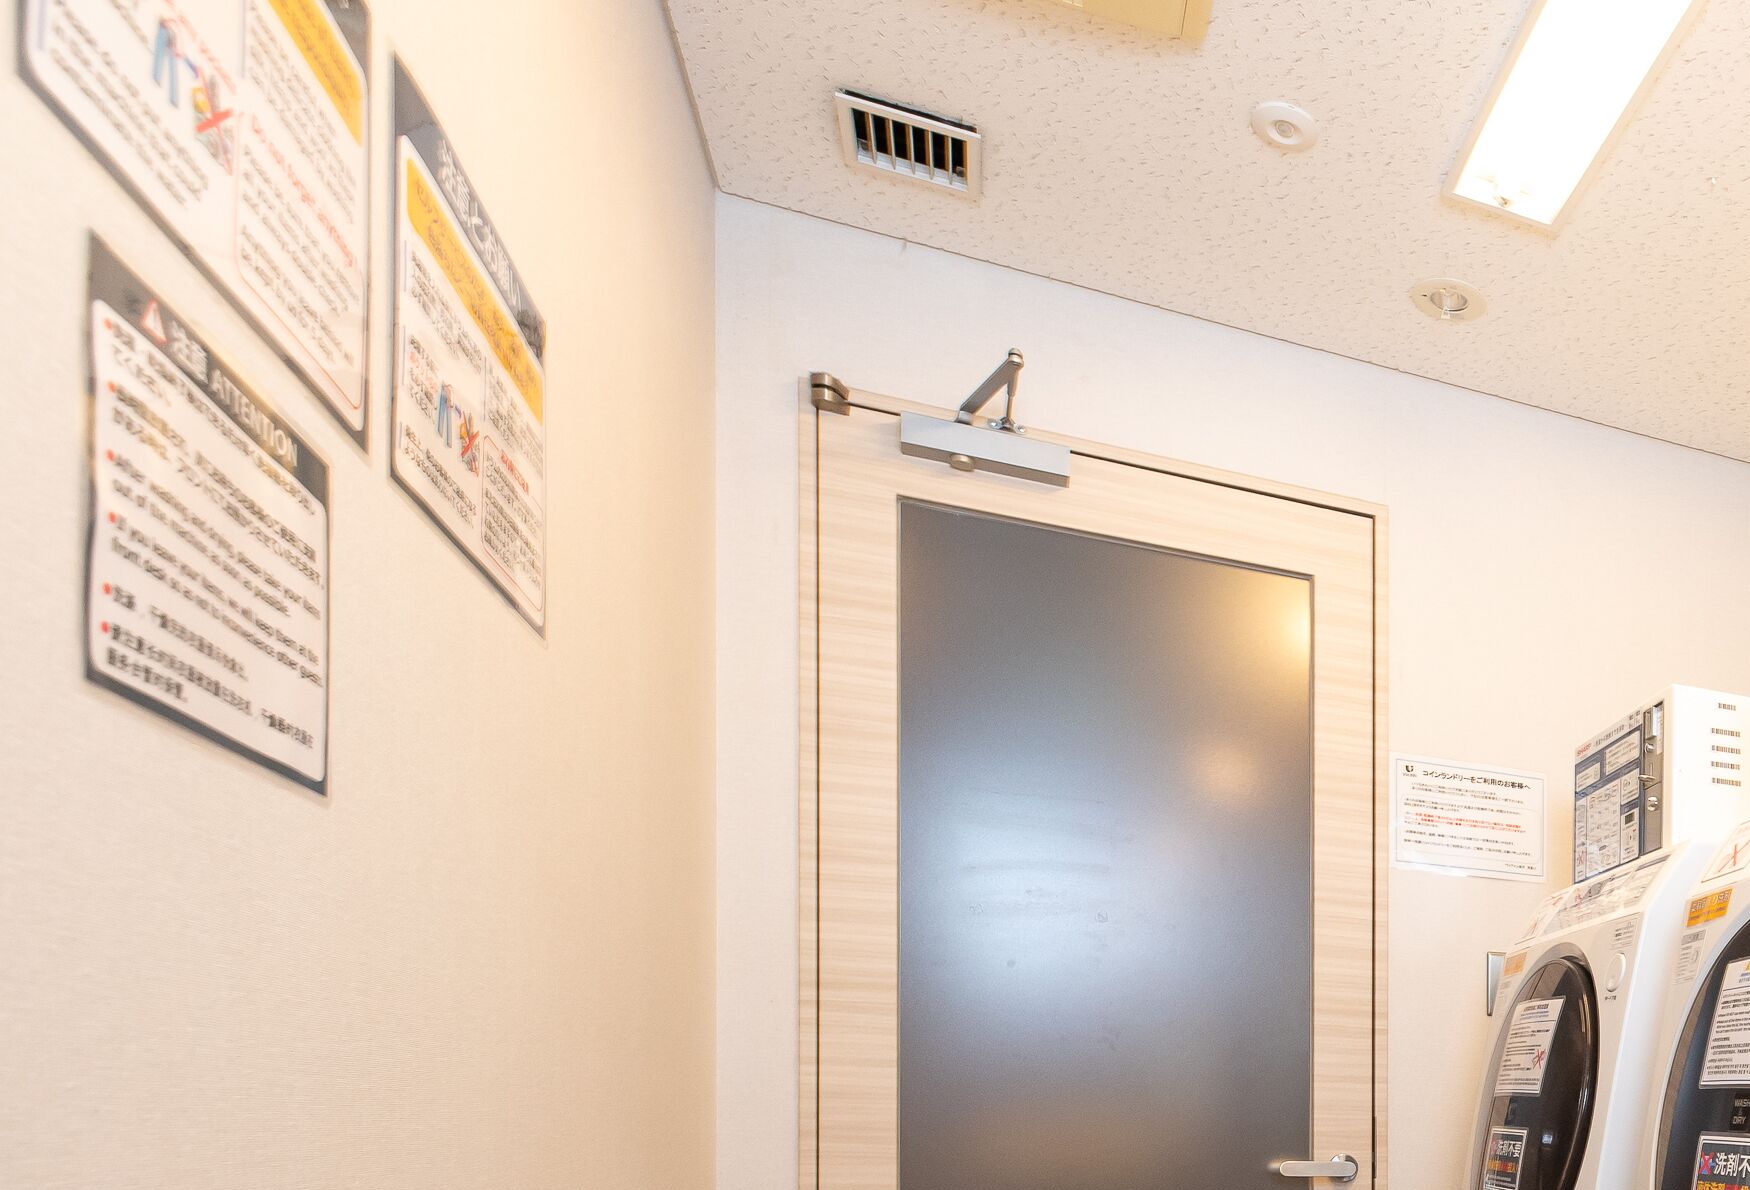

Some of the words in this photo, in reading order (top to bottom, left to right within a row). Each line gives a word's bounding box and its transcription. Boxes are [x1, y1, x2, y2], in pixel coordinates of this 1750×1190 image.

[210, 368, 298, 467] ATTENTION
[1422, 769, 1532, 790] コインランドリーをご利用のお客様へ
[1732, 1116, 1747, 1125] DRY
